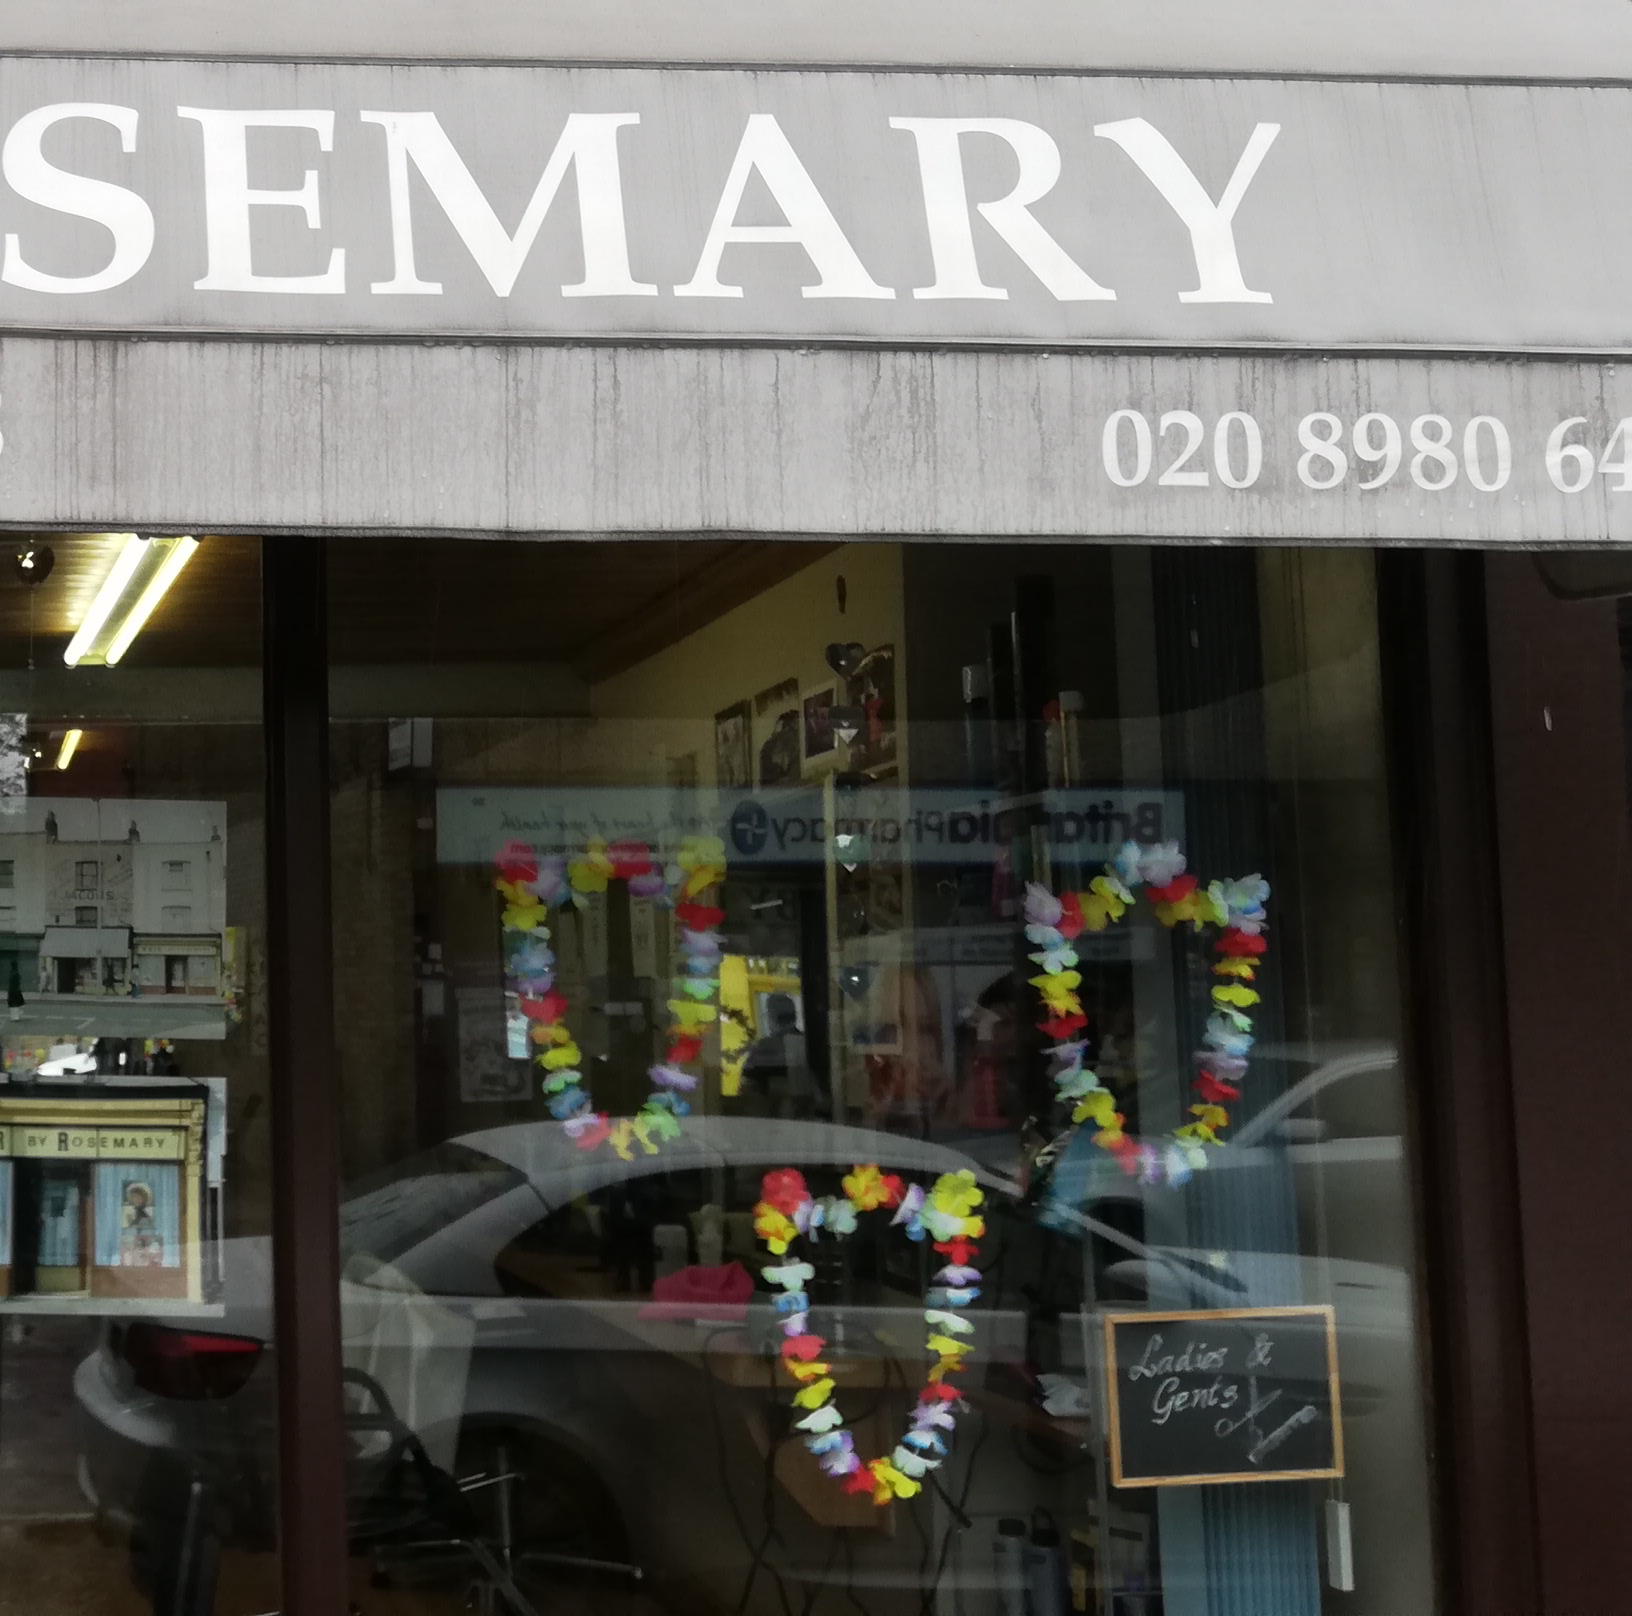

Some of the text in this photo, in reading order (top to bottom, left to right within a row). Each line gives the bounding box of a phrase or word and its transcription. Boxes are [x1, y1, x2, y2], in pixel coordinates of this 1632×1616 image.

[1102, 409, 1263, 489] 020
[1297, 412, 1511, 492] 8980
[27, 1135, 48, 1148] BY
[1128, 1332, 1275, 1381] Ladies &
[1151, 1376, 1239, 1426] Gents
